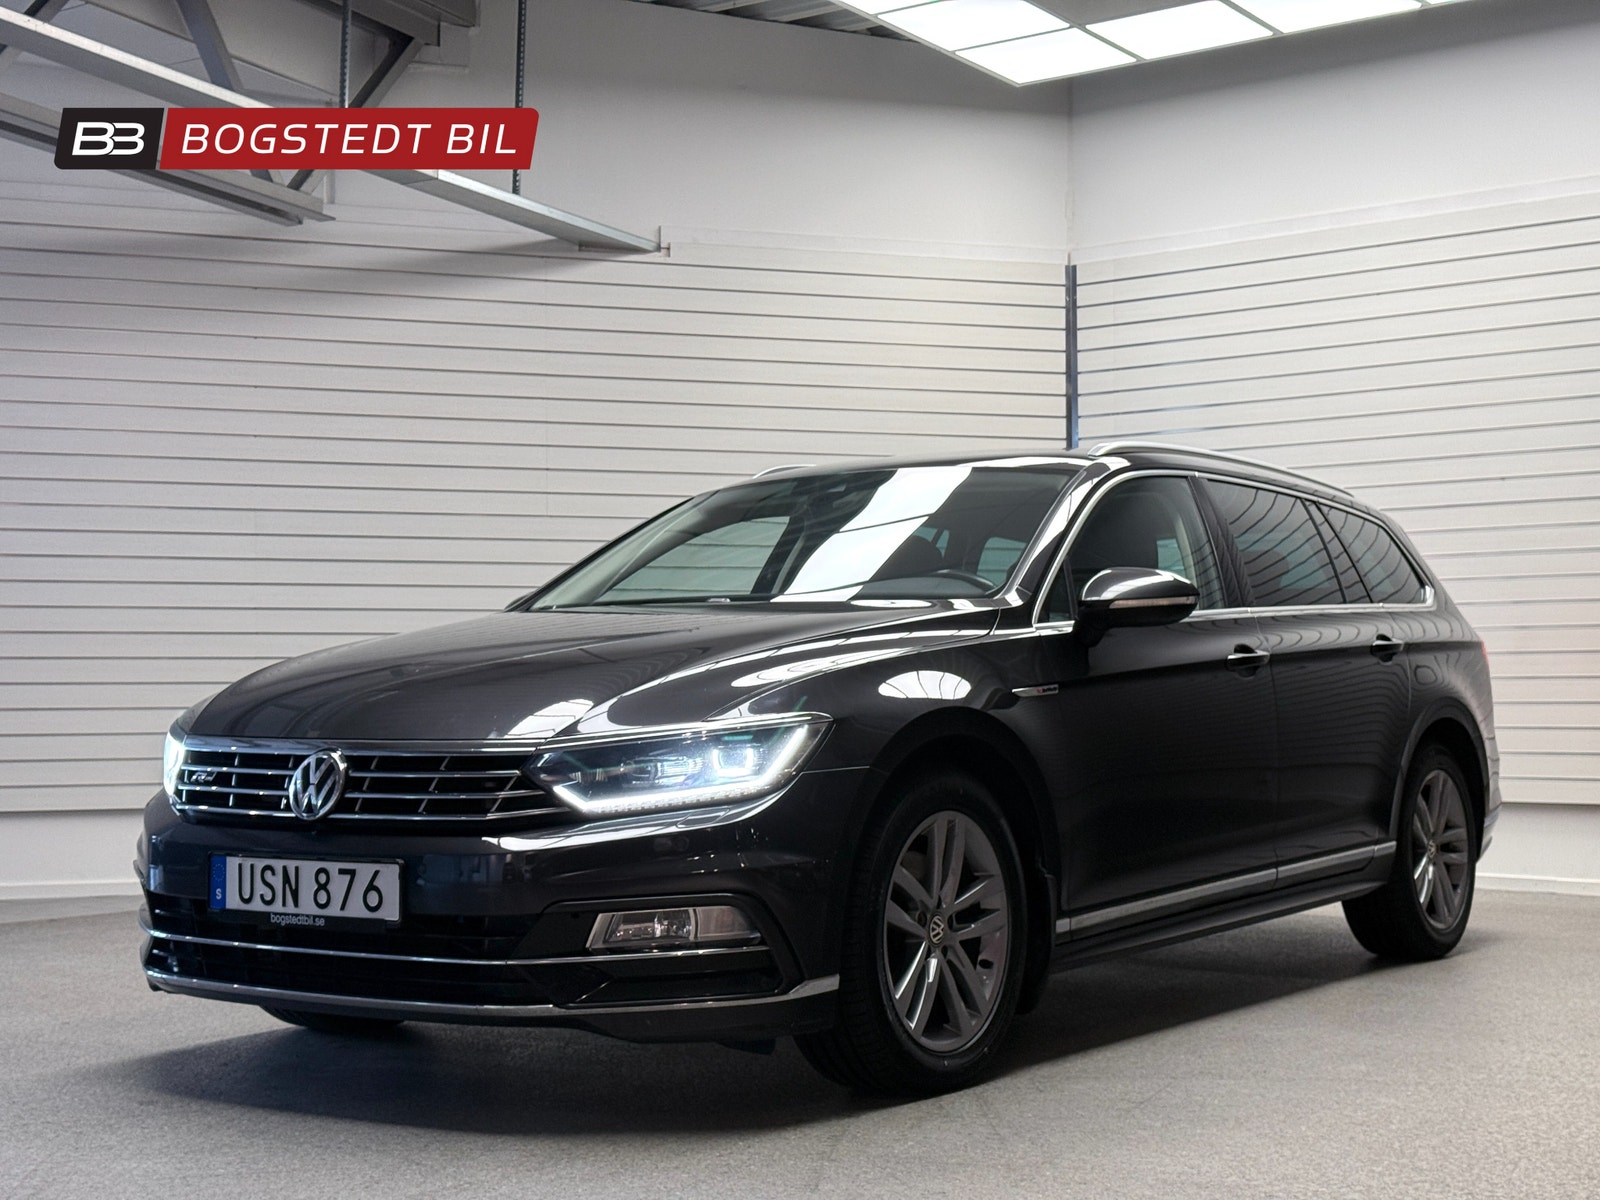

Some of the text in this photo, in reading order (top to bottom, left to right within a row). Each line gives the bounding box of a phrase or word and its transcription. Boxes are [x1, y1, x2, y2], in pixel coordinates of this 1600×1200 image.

[215, 888, 222, 900] S
[237, 862, 383, 912] USN 876
